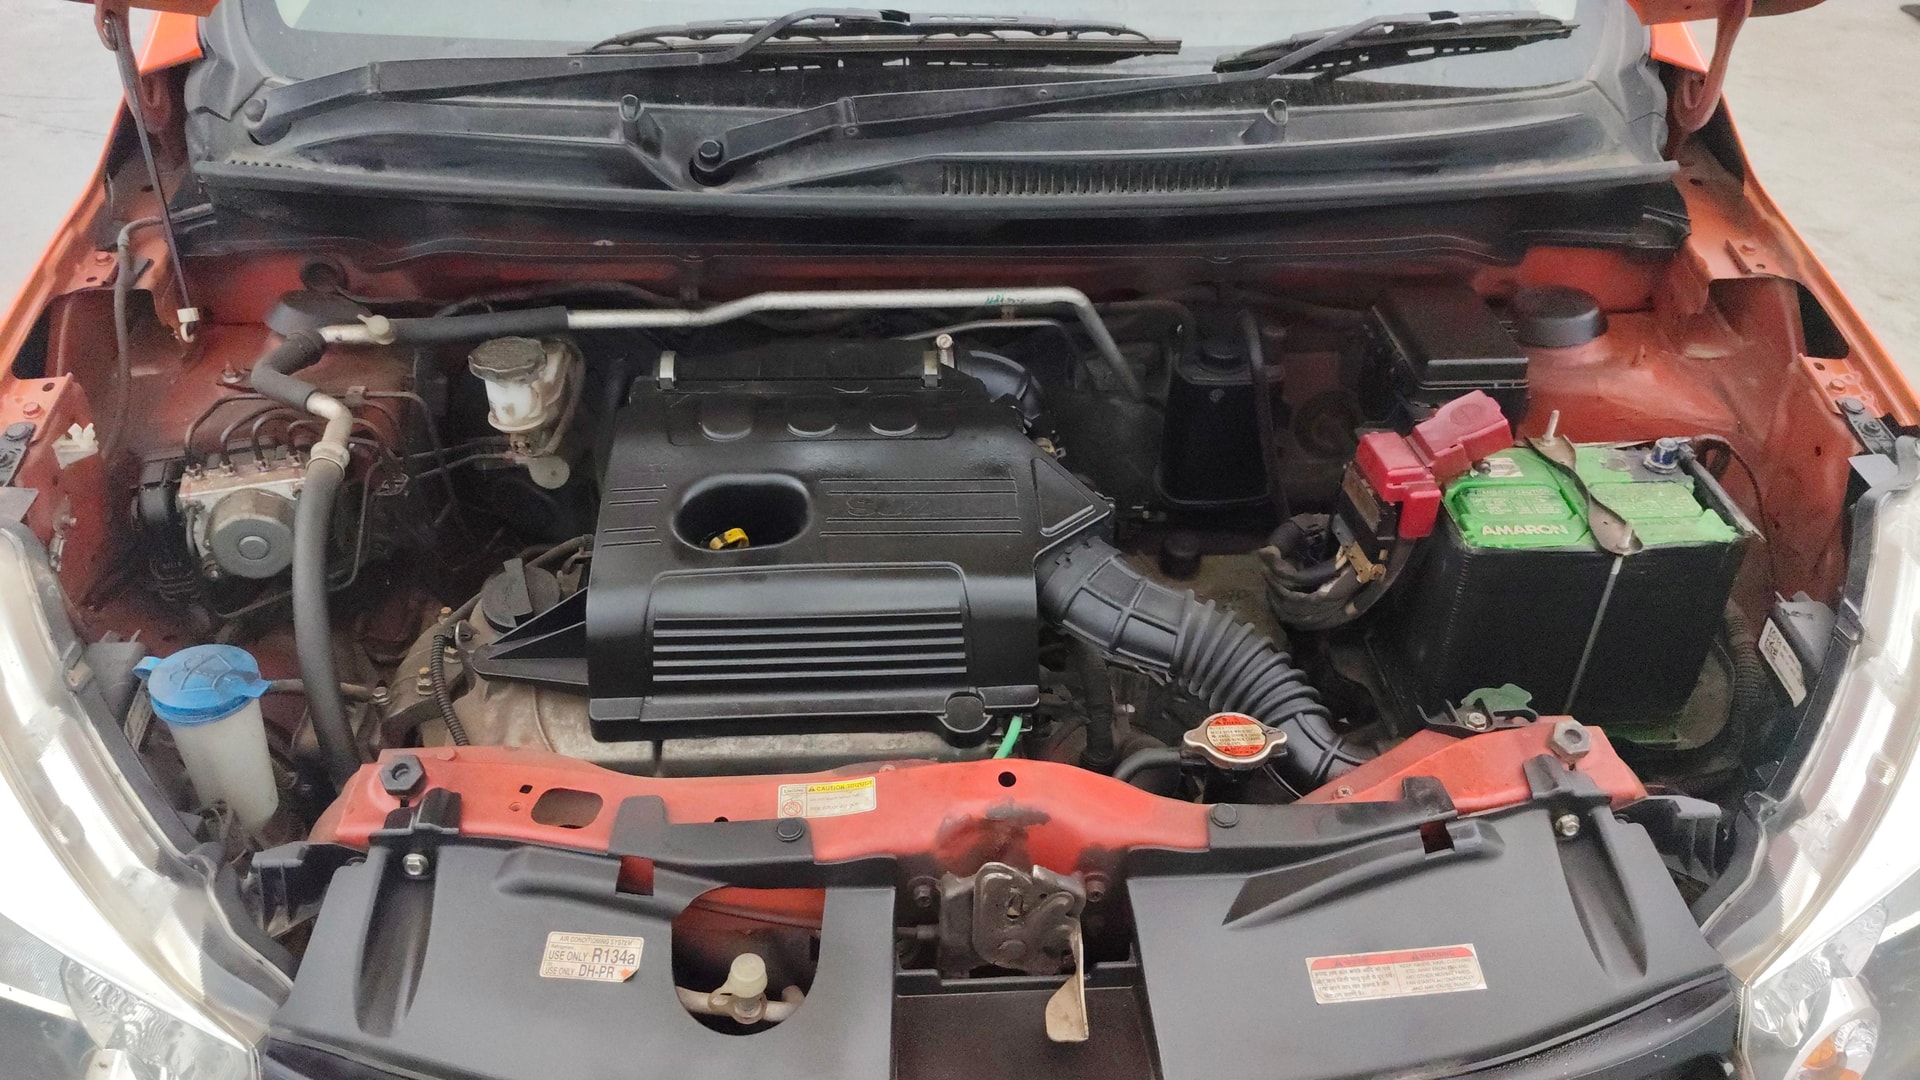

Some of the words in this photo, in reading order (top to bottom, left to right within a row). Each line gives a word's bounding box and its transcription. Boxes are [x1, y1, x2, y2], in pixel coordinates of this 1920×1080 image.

[1482, 524, 1569, 536] AMARON
[816, 784, 845, 792] CAUTION
[570, 936, 609, 945] CONDITIONING
[548, 950, 566, 960] USE
[567, 951, 589, 962] ONLY
[591, 947, 636, 965] R134a
[545, 966, 557, 975] USE
[558, 967, 575, 976] ONLY
[578, 964, 615, 979] DH-PR
